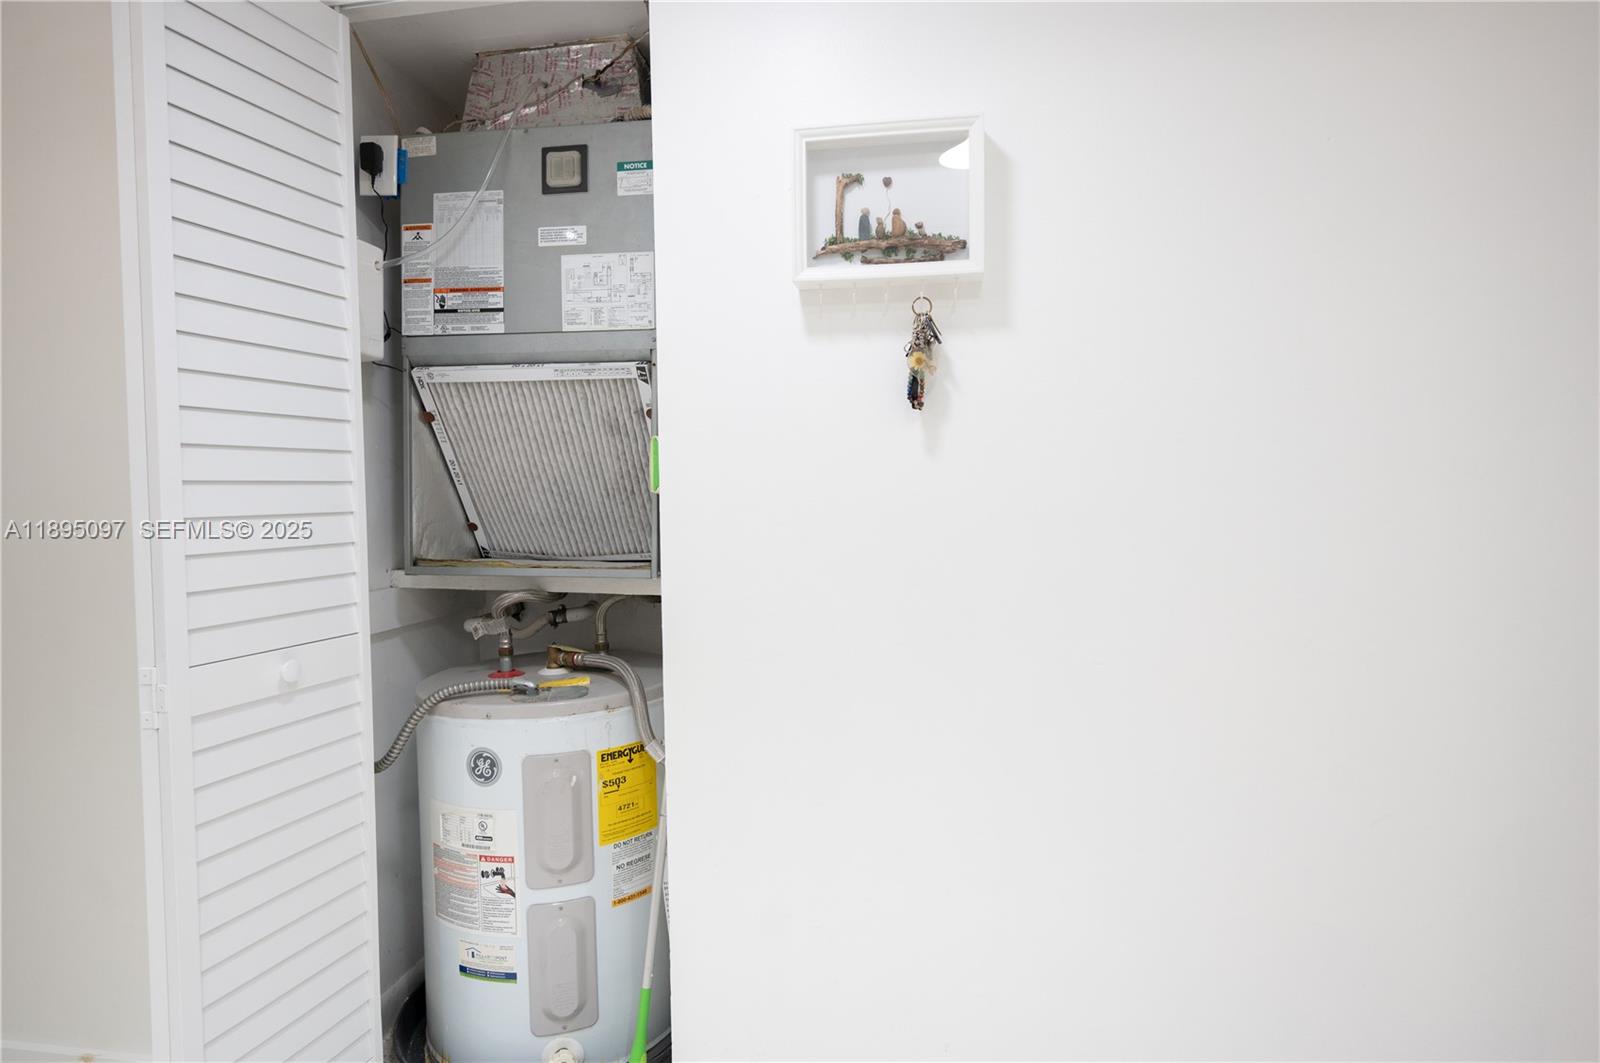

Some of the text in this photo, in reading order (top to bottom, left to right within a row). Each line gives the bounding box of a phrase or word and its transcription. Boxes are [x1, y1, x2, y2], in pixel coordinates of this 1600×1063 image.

[622, 837, 634, 846] NOT
[634, 831, 653, 841] RETURN
[626, 853, 651, 867] REGRESE
